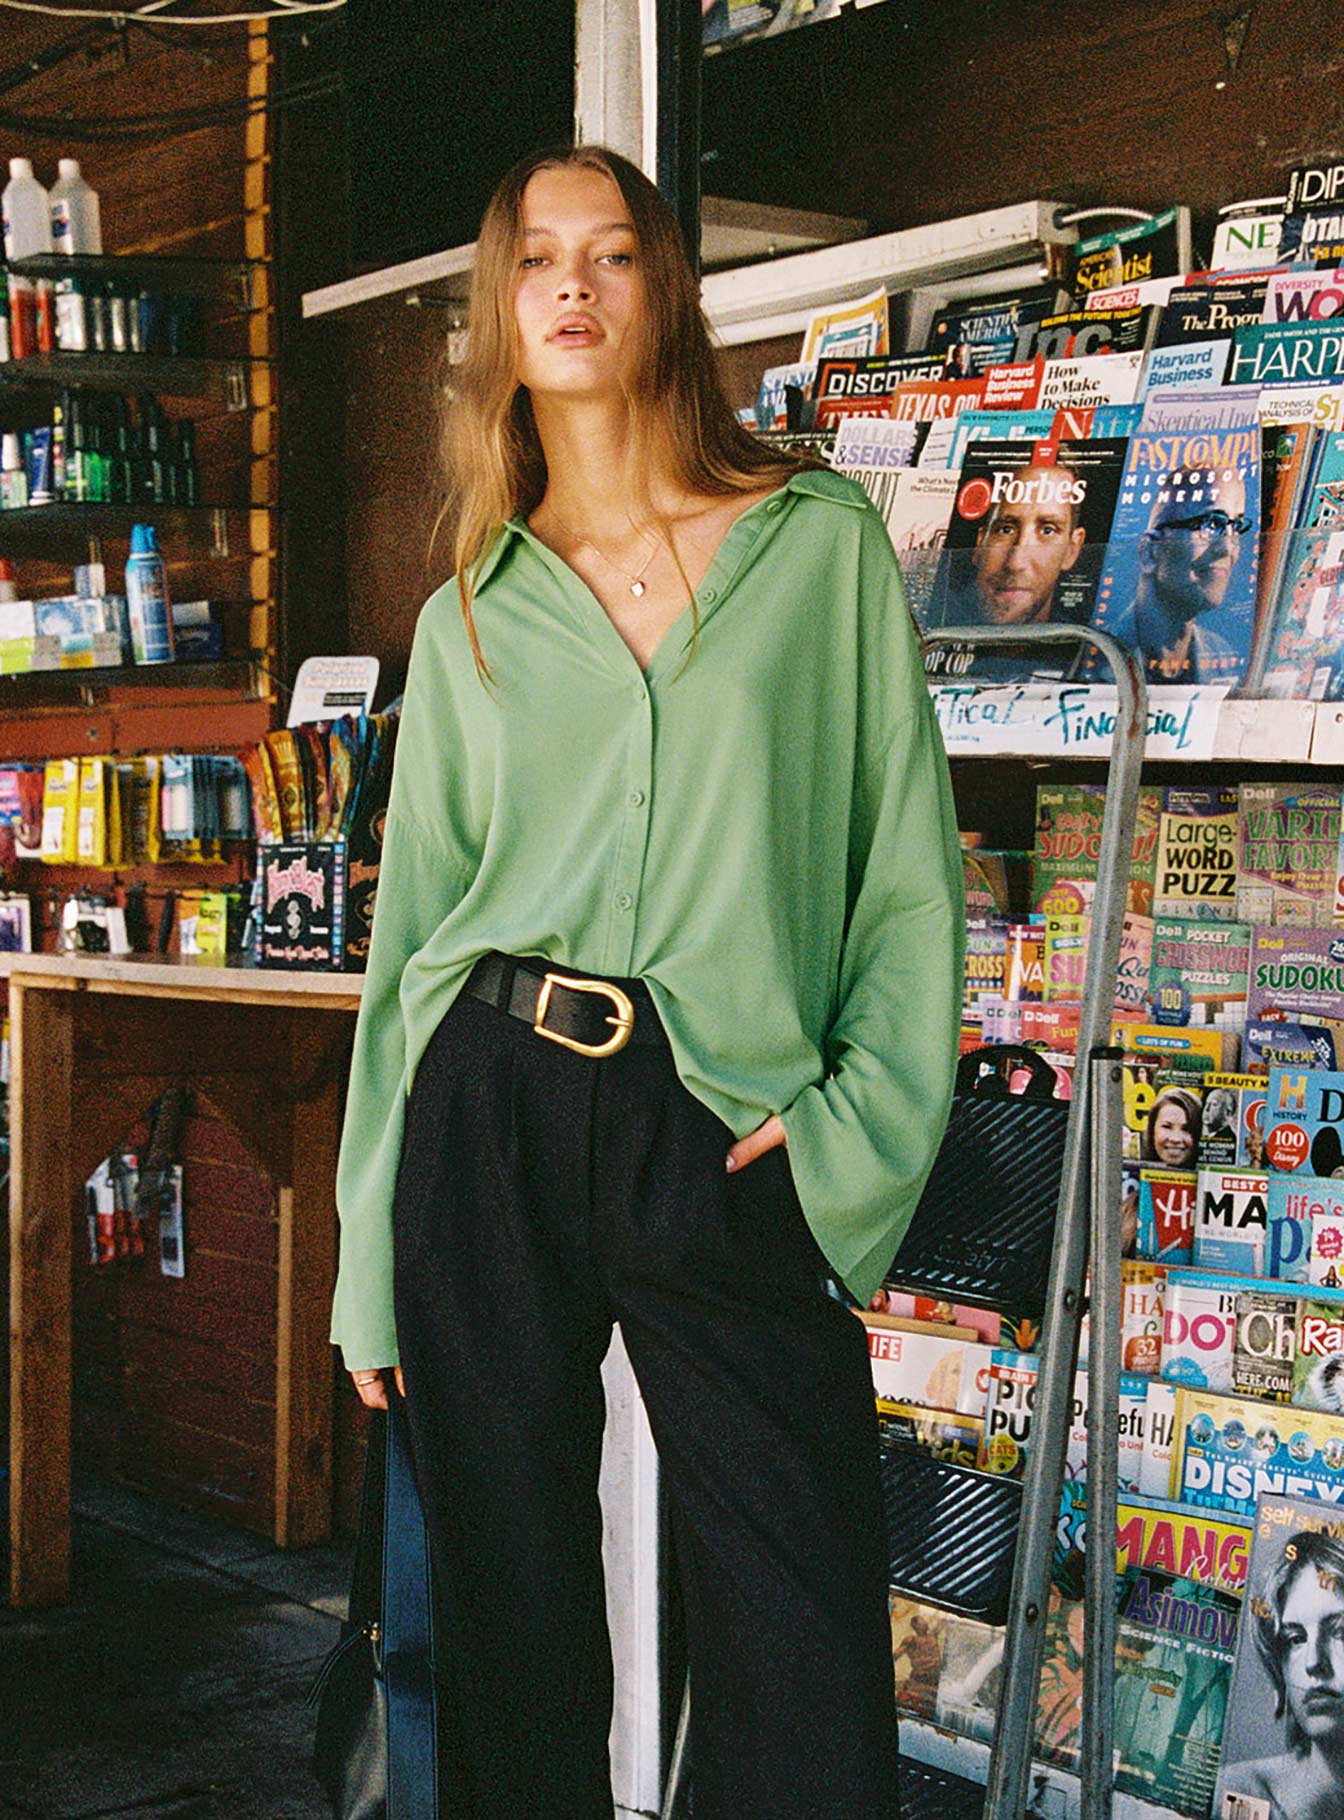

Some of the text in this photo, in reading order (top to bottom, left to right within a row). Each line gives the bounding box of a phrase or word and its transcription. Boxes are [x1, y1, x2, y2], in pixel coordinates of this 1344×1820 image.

[1275, 280, 1324, 292] DIVERSITY
[1014, 323, 1111, 361] Inc.
[1152, 348, 1212, 370] Harvard
[989, 365, 1035, 380] Harvard
[1049, 365, 1079, 380] How
[1148, 366, 1213, 386] Business
[1044, 377, 1100, 396] to Make
[896, 394, 952, 421] TEXAS
[1042, 394, 1111, 410] Decisions
[991, 471, 1087, 505] Forbes
[1121, 488, 1221, 505] MOMENT
[1243, 787, 1276, 800] Dell
[1166, 847, 1234, 870] WORD
[1162, 873, 1237, 897] PUZZ
[1042, 896, 1080, 916] 600
[1049, 921, 1080, 932] Dell
[1156, 925, 1182, 936] Dell
[1186, 929, 1232, 943] POCKET
[1257, 937, 1284, 950] Dell
[1280, 952, 1329, 965] ORIGINAL
[1181, 970, 1232, 985] PUZZLES
[1161, 988, 1182, 1010] 100
[1159, 1038, 1169, 1046] OF
[1170, 1039, 1186, 1048] FUN
[1249, 1028, 1273, 1042] Dell
[1261, 1045, 1317, 1063] EXTREME
[1216, 1076, 1257, 1087] BEAUTY
[1279, 1074, 1308, 1110] H
[1273, 1111, 1308, 1121] HISTORY
[1275, 1130, 1305, 1148] 100
[1223, 1179, 1256, 1191] BEST
[1138, 1338, 1157, 1356] 32
[990, 1443, 1016, 1456] CATS
[1261, 1505, 1295, 1527] self
[1258, 1523, 1272, 1539] e
[1285, 1544, 1298, 1561] s
[1125, 1575, 1238, 1650] Asimov
[1119, 1623, 1182, 1649] SCIENCE
